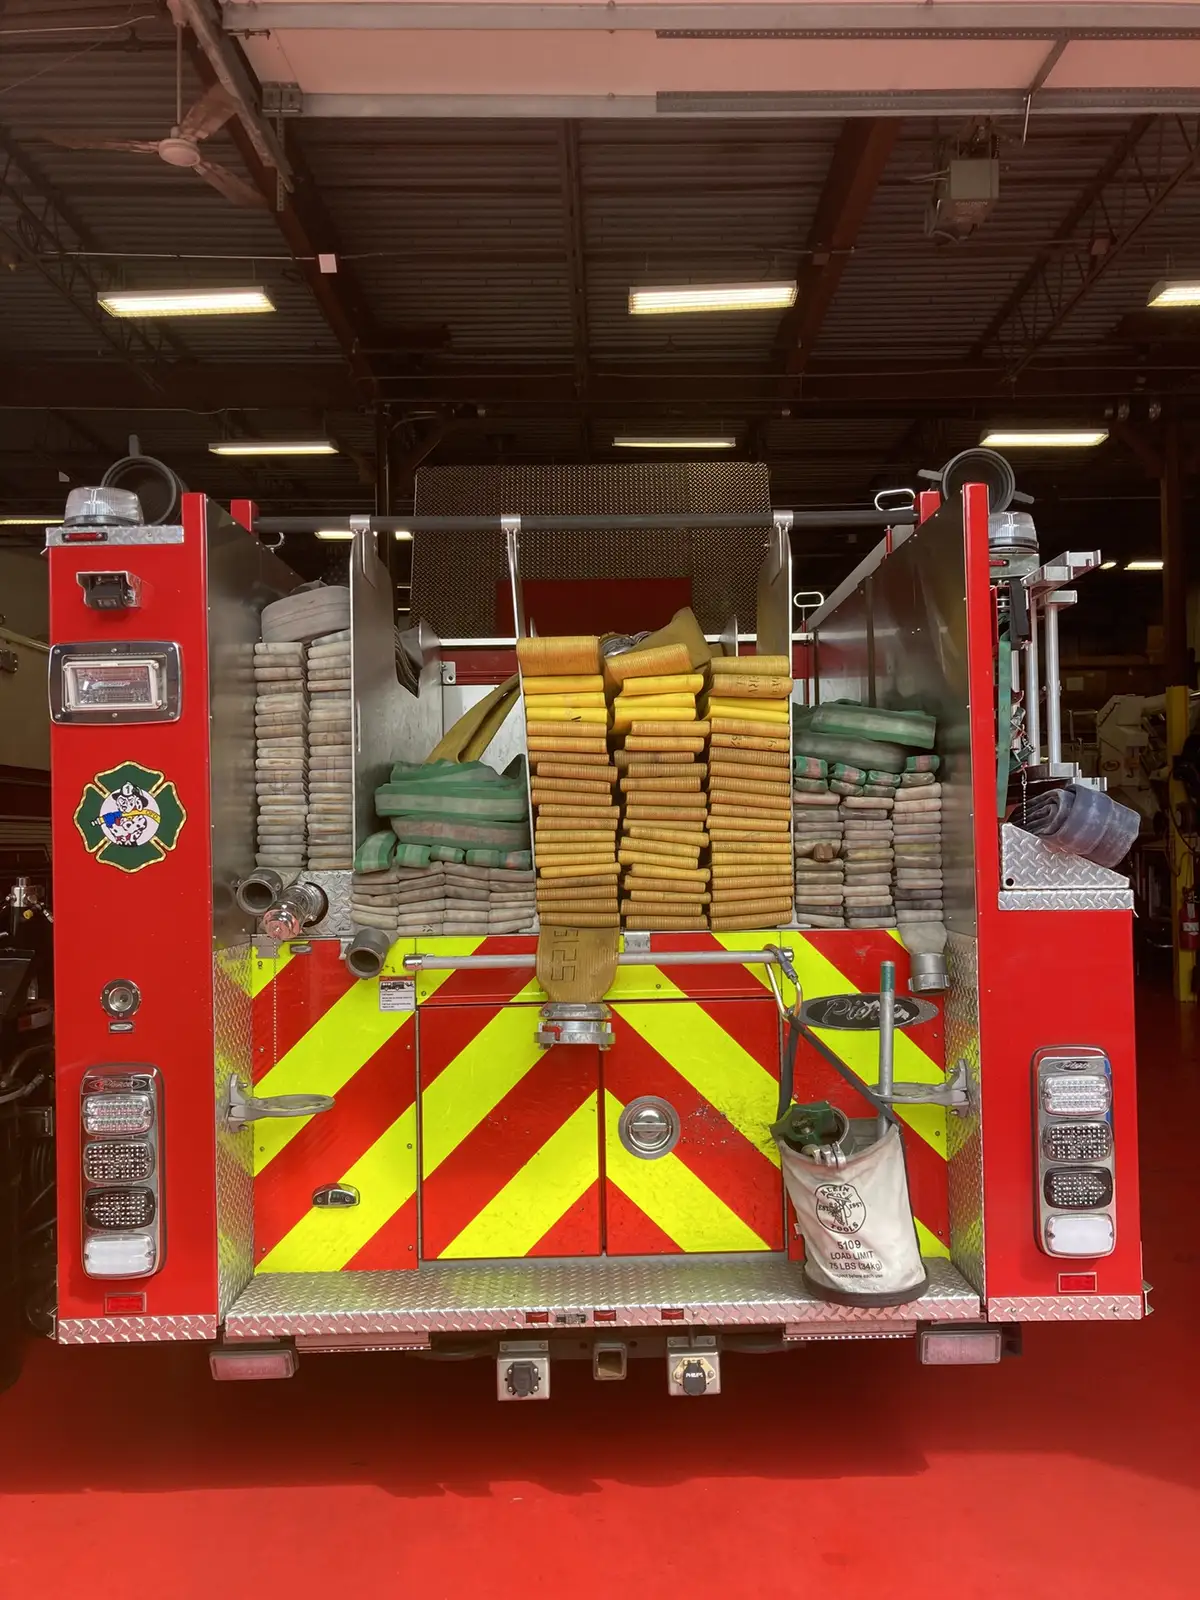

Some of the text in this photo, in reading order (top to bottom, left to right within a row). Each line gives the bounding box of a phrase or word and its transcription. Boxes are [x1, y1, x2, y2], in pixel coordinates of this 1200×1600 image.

[820, 1186, 849, 1196] KLEIN
[830, 1222, 859, 1232] TOOLS
[837, 1240, 862, 1250] 5109
[830, 1251, 874, 1260] LOAD LIMIT
[829, 1260, 883, 1272] 75 LBS (34kg)
